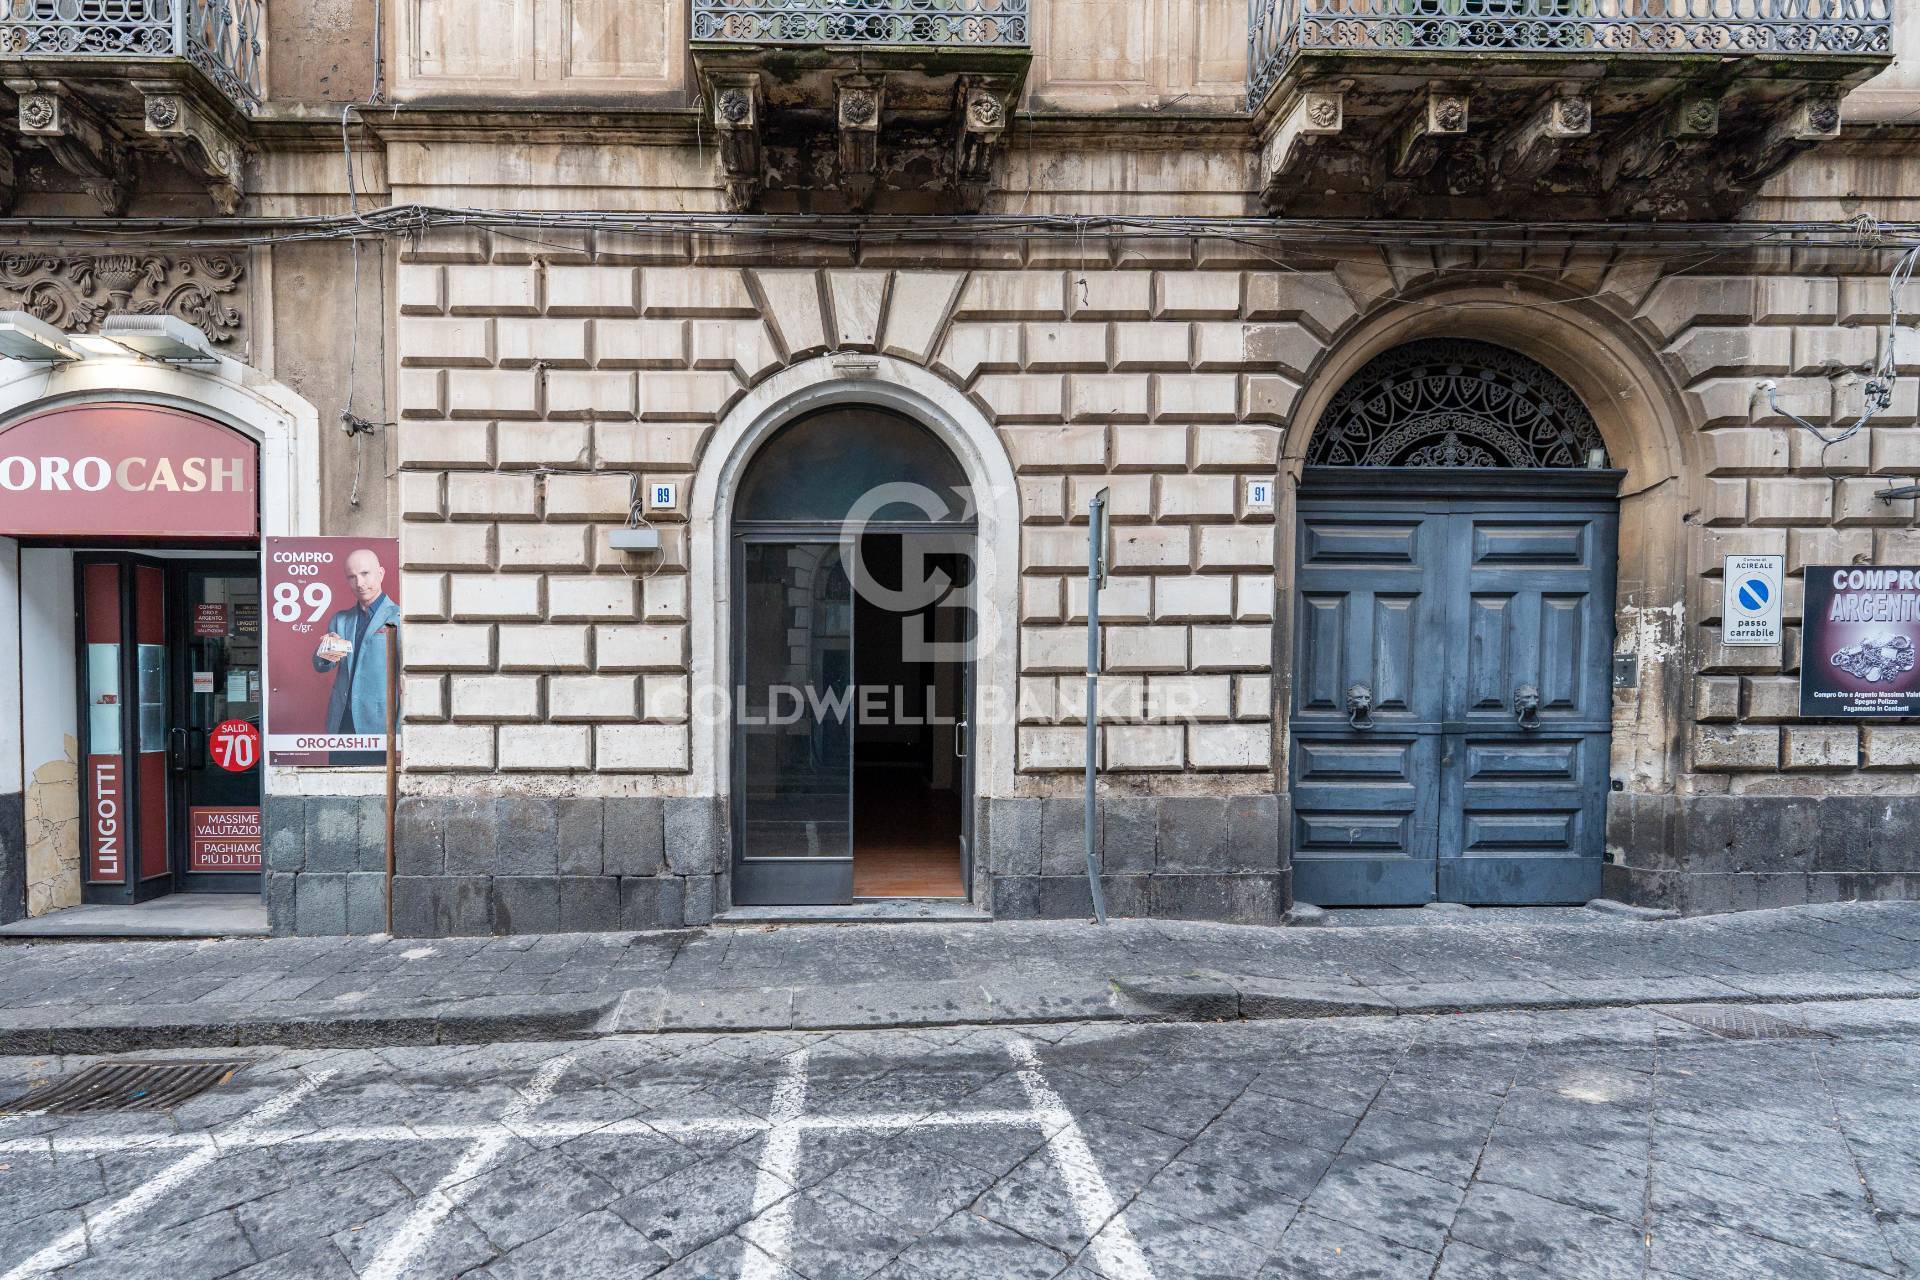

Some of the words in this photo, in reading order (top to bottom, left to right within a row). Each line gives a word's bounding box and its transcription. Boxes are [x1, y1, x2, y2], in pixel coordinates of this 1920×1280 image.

[0, 455, 244, 492] OROCASH
[657, 487, 670, 503] 89
[1255, 486, 1265, 502] 91
[273, 551, 334, 563] COMPRO
[287, 564, 319, 576] ORO
[272, 581, 332, 623] 89
[1730, 629, 1774, 637] carrabile
[1813, 691, 1837, 699] Compro
[1854, 691, 1878, 699] Argento
[1843, 705, 1876, 713] Pagamento
[221, 723, 248, 733] SALDI
[296, 737, 380, 749] OROCASH.IT
[96, 764, 118, 874] LINGOTTI
[208, 814, 259, 824] MASSIME
[201, 852, 219, 864] PIÙ
[222, 854, 233, 864] DI
